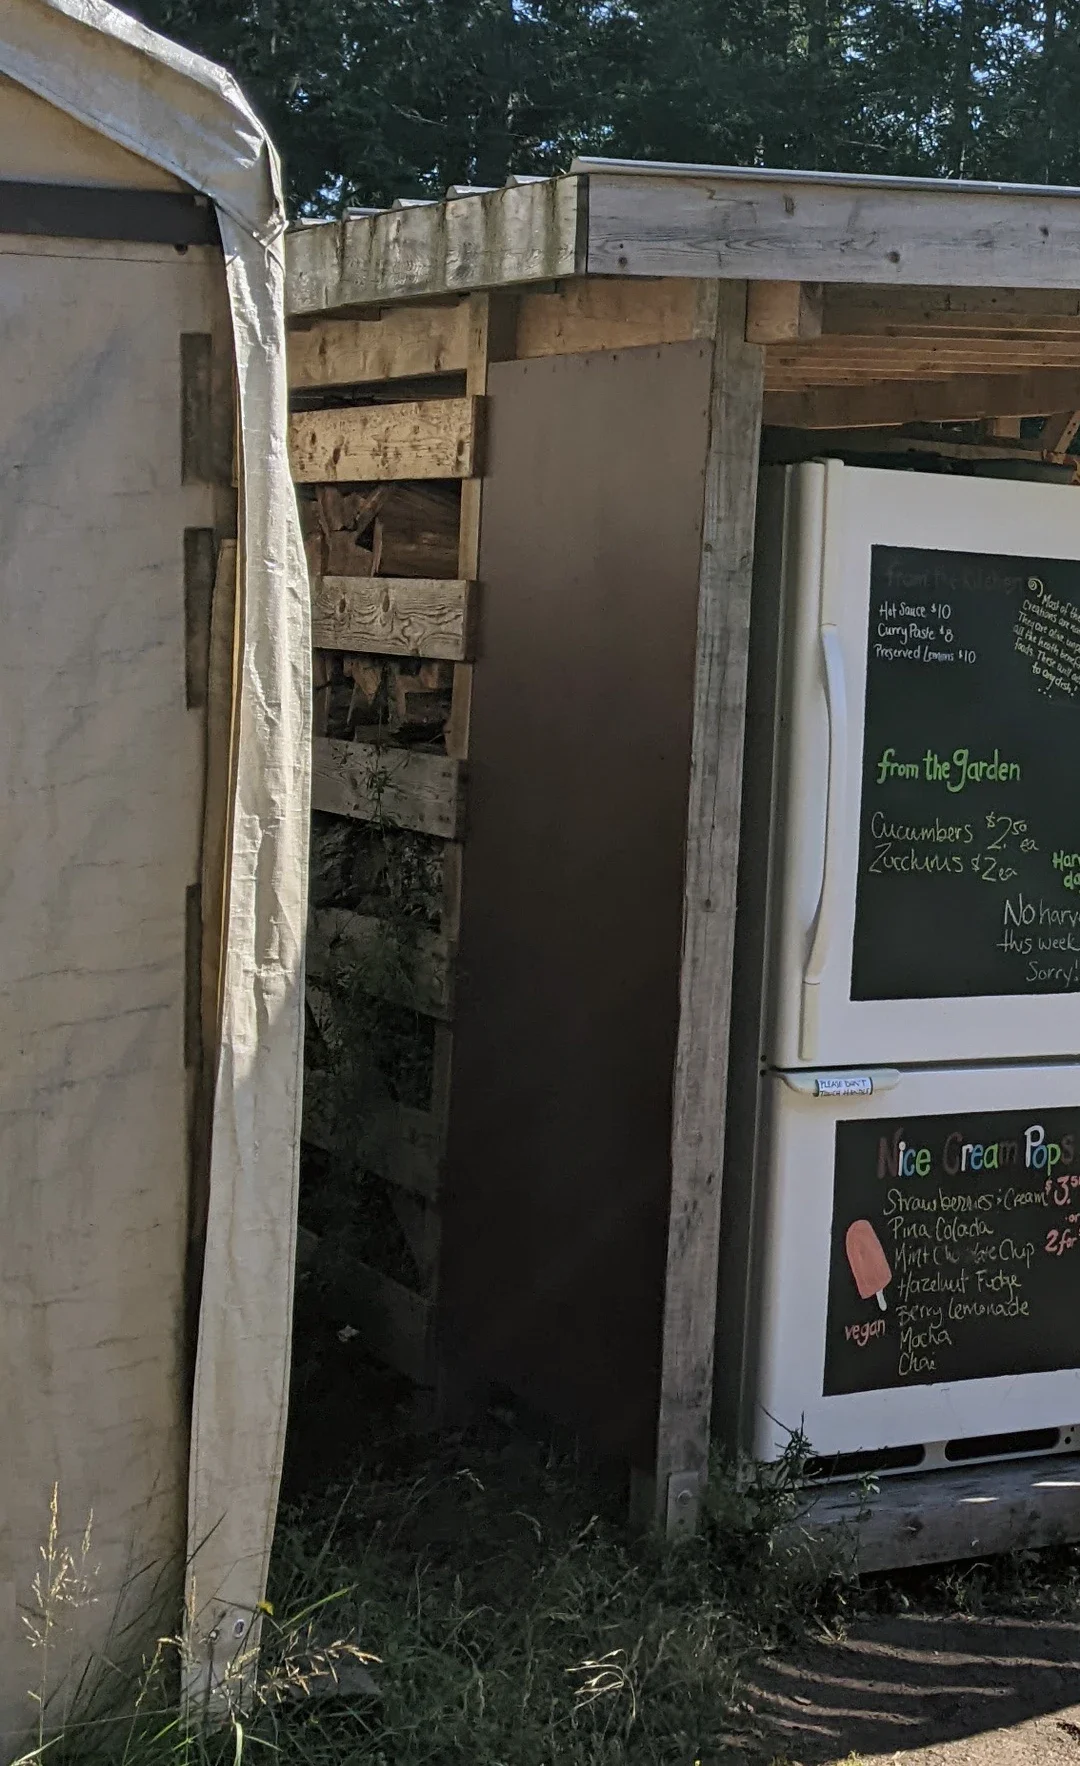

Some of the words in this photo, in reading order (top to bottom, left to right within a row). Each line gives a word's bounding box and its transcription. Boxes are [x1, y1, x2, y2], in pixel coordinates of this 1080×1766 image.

[879, 601, 898, 620] Hot
[899, 601, 926, 618] Sauce
[930, 603, 951, 620] $10
[1060, 602, 1072, 616] of
[877, 622, 908, 645] Curry
[908, 622, 936, 640] Paste
[939, 625, 954, 643] $8
[873, 643, 921, 661] Preserved
[923, 644, 954, 663] Lemons
[958, 649, 977, 664] $10
[877, 748, 919, 784] from
[922, 749, 950, 782] the
[946, 748, 1021, 793] garden
[871, 811, 974, 844] Cucumbers
[971, 854, 997, 882] $2
[998, 867, 1019, 882] ea
[1003, 892, 1036, 927] No
[996, 929, 1033, 955] this
[1026, 959, 1080, 988] Sorry!
[877, 1128, 932, 1179] Nice
[943, 1131, 1018, 1176] Cream
[1023, 1124, 1076, 1176] Pops
[883, 1187, 994, 1216] Strawberries
[1003, 1187, 1049, 1211] Cream
[935, 1215, 994, 1242] Colada
[1056, 1228, 1078, 1256] for
[894, 1242, 931, 1273] Mint
[999, 1238, 1035, 1269] Chip
[898, 1268, 969, 1302] Hazelnut
[975, 1269, 1022, 1304] Fudge
[844, 1318, 886, 1347] vegan
[898, 1351, 937, 1376] Chai
